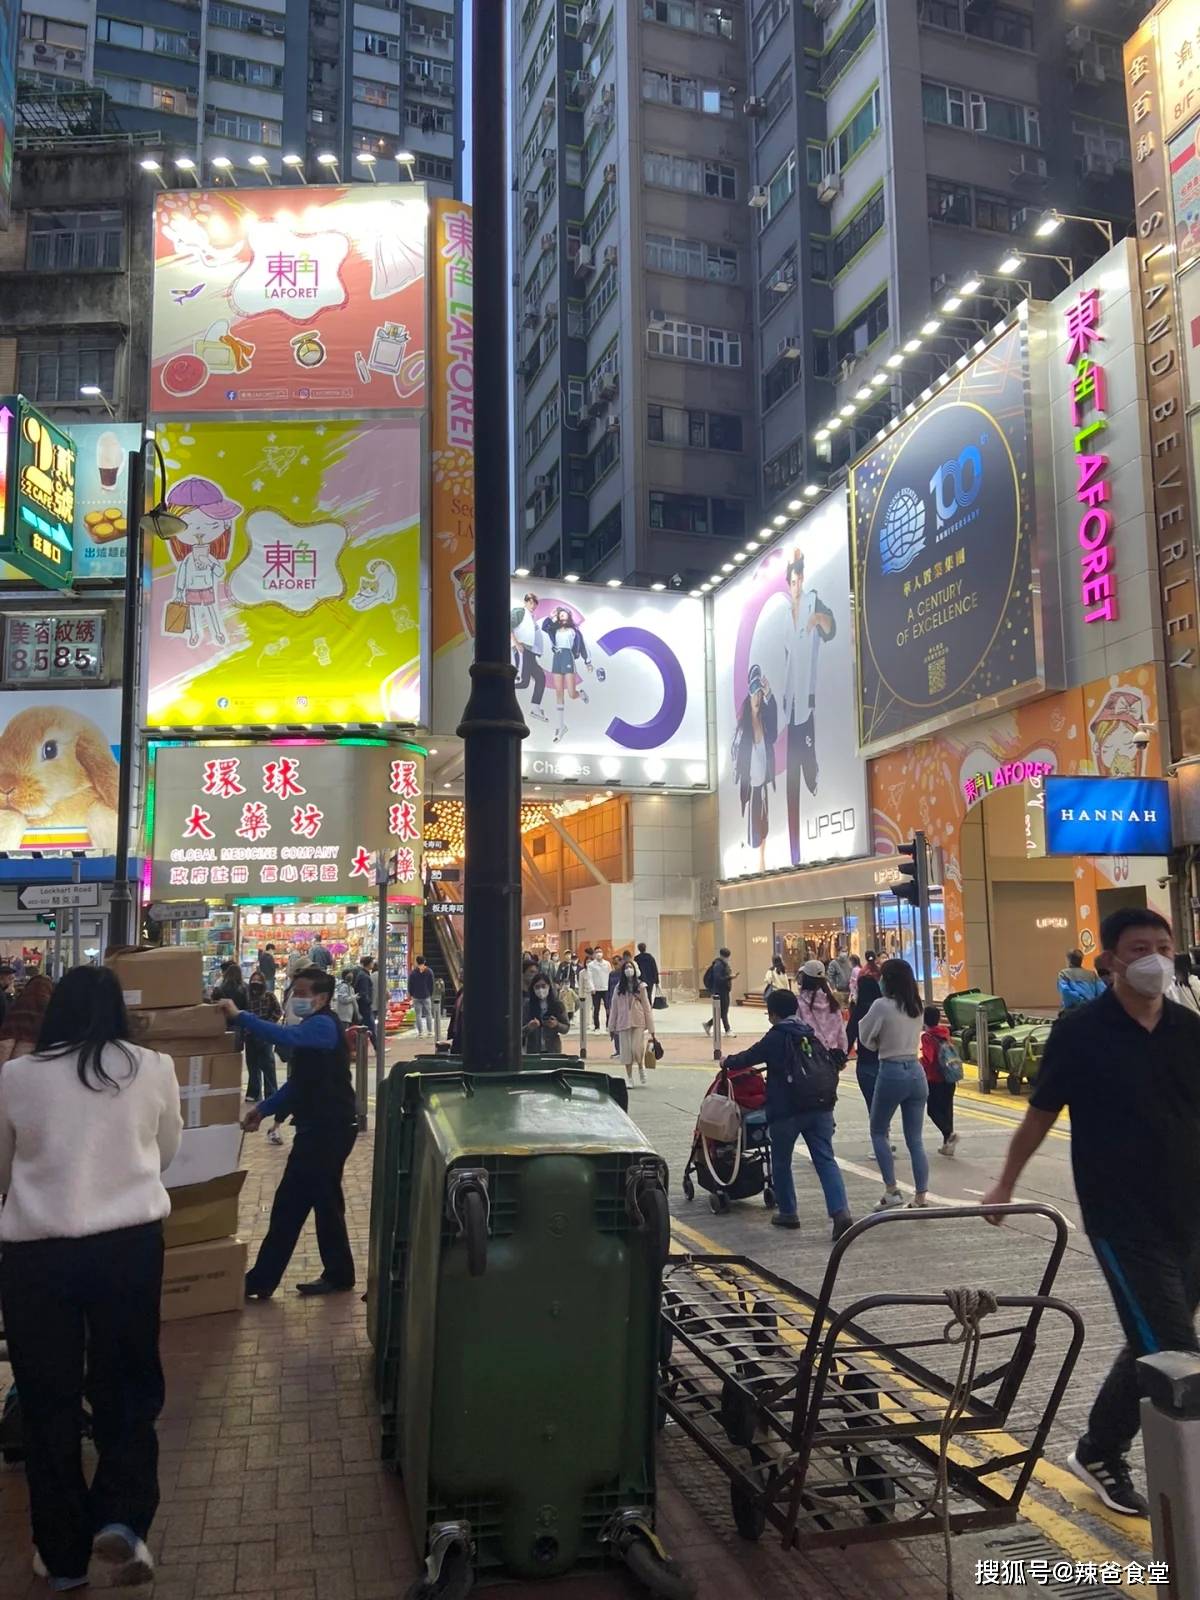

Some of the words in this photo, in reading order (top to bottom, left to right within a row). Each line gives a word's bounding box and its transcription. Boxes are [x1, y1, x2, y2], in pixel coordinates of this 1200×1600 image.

[1129, 55, 1152, 162] 金百利
[264, 251, 318, 287] 東角
[1138, 187, 1175, 376] ISLAND
[264, 288, 318, 298] LAFORET
[1064, 288, 1105, 427] 東角
[936, 508, 980, 543] ANNIVERSARY
[1074, 419, 1118, 624] LAFORET
[1154, 400, 1193, 668] BEVERLEY
[263, 540, 316, 578] 東角
[263, 579, 316, 590] LAFORET
[907, 607, 915, 623] A
[917, 579, 962, 616] CENTURY
[896, 628, 909, 647] OF
[912, 592, 978, 639] EXCELLENCE
[12, 647, 92, 672] 8585
[202, 758, 306, 800] 環球
[985, 761, 1054, 791] LAFORET
[182, 802, 324, 841] 大藥坊
[806, 808, 855, 839] UPSO
[1061, 809, 1157, 822] HANNAH
[170, 848, 217, 861] GLOBAL
[221, 847, 277, 861] MEDICINE
[281, 846, 339, 859] COMPANY
[40, 887, 70, 895] Lockhart
[170, 866, 249, 885] 政府註冊
[260, 865, 338, 883] 信心保證
